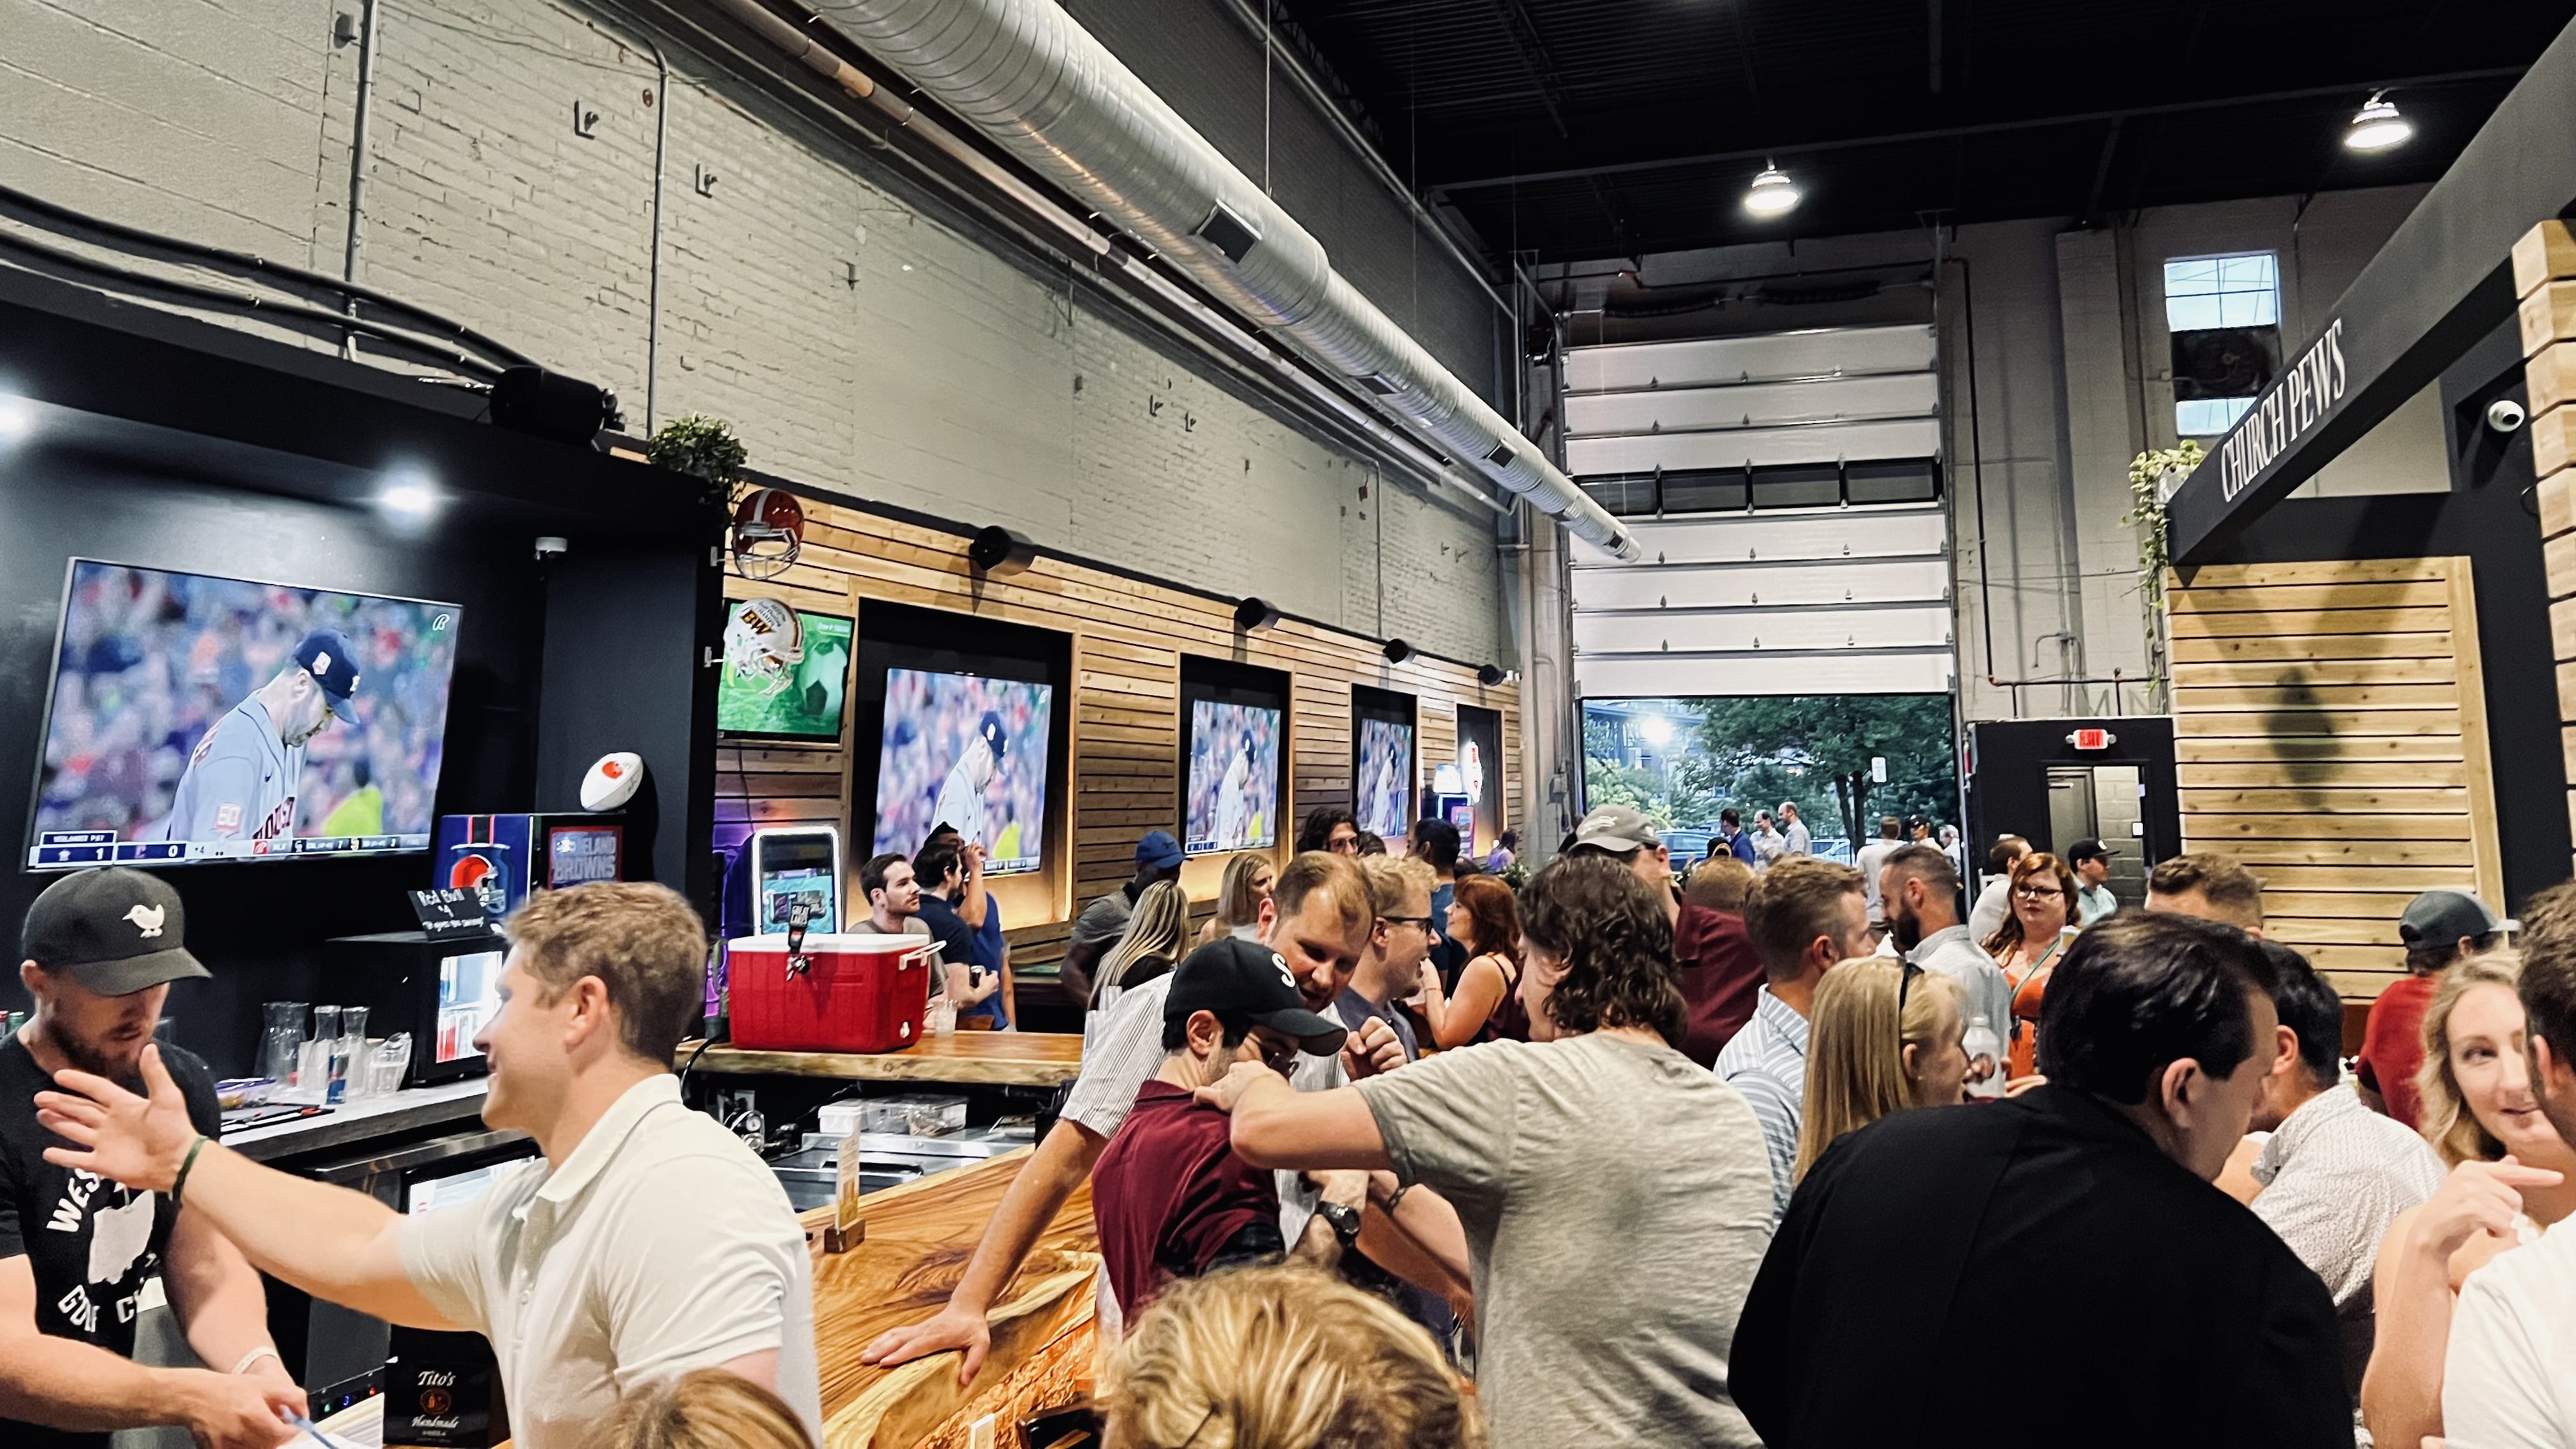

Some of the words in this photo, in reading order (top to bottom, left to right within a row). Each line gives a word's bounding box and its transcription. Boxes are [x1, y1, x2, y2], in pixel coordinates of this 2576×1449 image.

[2221, 383, 2287, 502] CHURCH
[2287, 317, 2345, 442] PEWS
[741, 610, 776, 635] BW
[168, 845, 178, 858] 0
[553, 856, 616, 880] BROWNS
[417, 889, 442, 907] Red
[1272, 953, 1296, 987] S
[46, 1167, 100, 1232] WES
[417, 1370, 457, 1387] Tito's
[411, 1414, 460, 1429] Handmade
